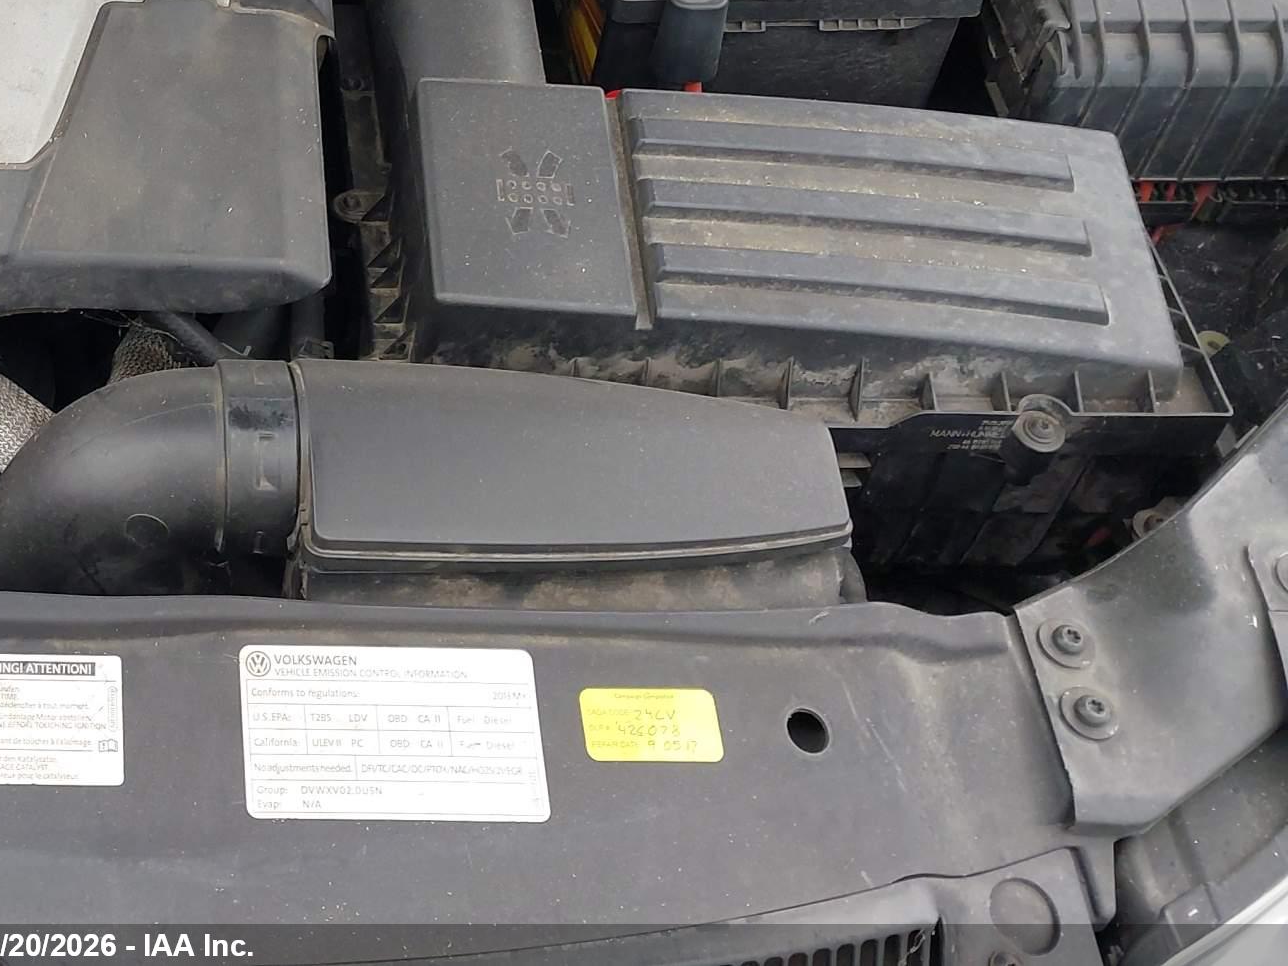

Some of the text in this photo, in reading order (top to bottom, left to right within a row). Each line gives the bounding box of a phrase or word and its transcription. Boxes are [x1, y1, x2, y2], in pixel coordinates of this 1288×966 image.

[273, 653, 357, 666] VOLKSWAGEN
[26, 662, 94, 676] ATTENTION!
[274, 667, 468, 680] VEHICLE EMISSION CONTROL INFORMATION
[250, 687, 294, 698] Conforms
[295, 689, 306, 698] to
[348, 713, 368, 723] LDV
[387, 714, 408, 723] OBD
[417, 714, 431, 723] CA
[351, 738, 365, 749] PC
[390, 739, 411, 749] OBD
[256, 785, 289, 797] Group:
[302, 799, 323, 810] N/A
